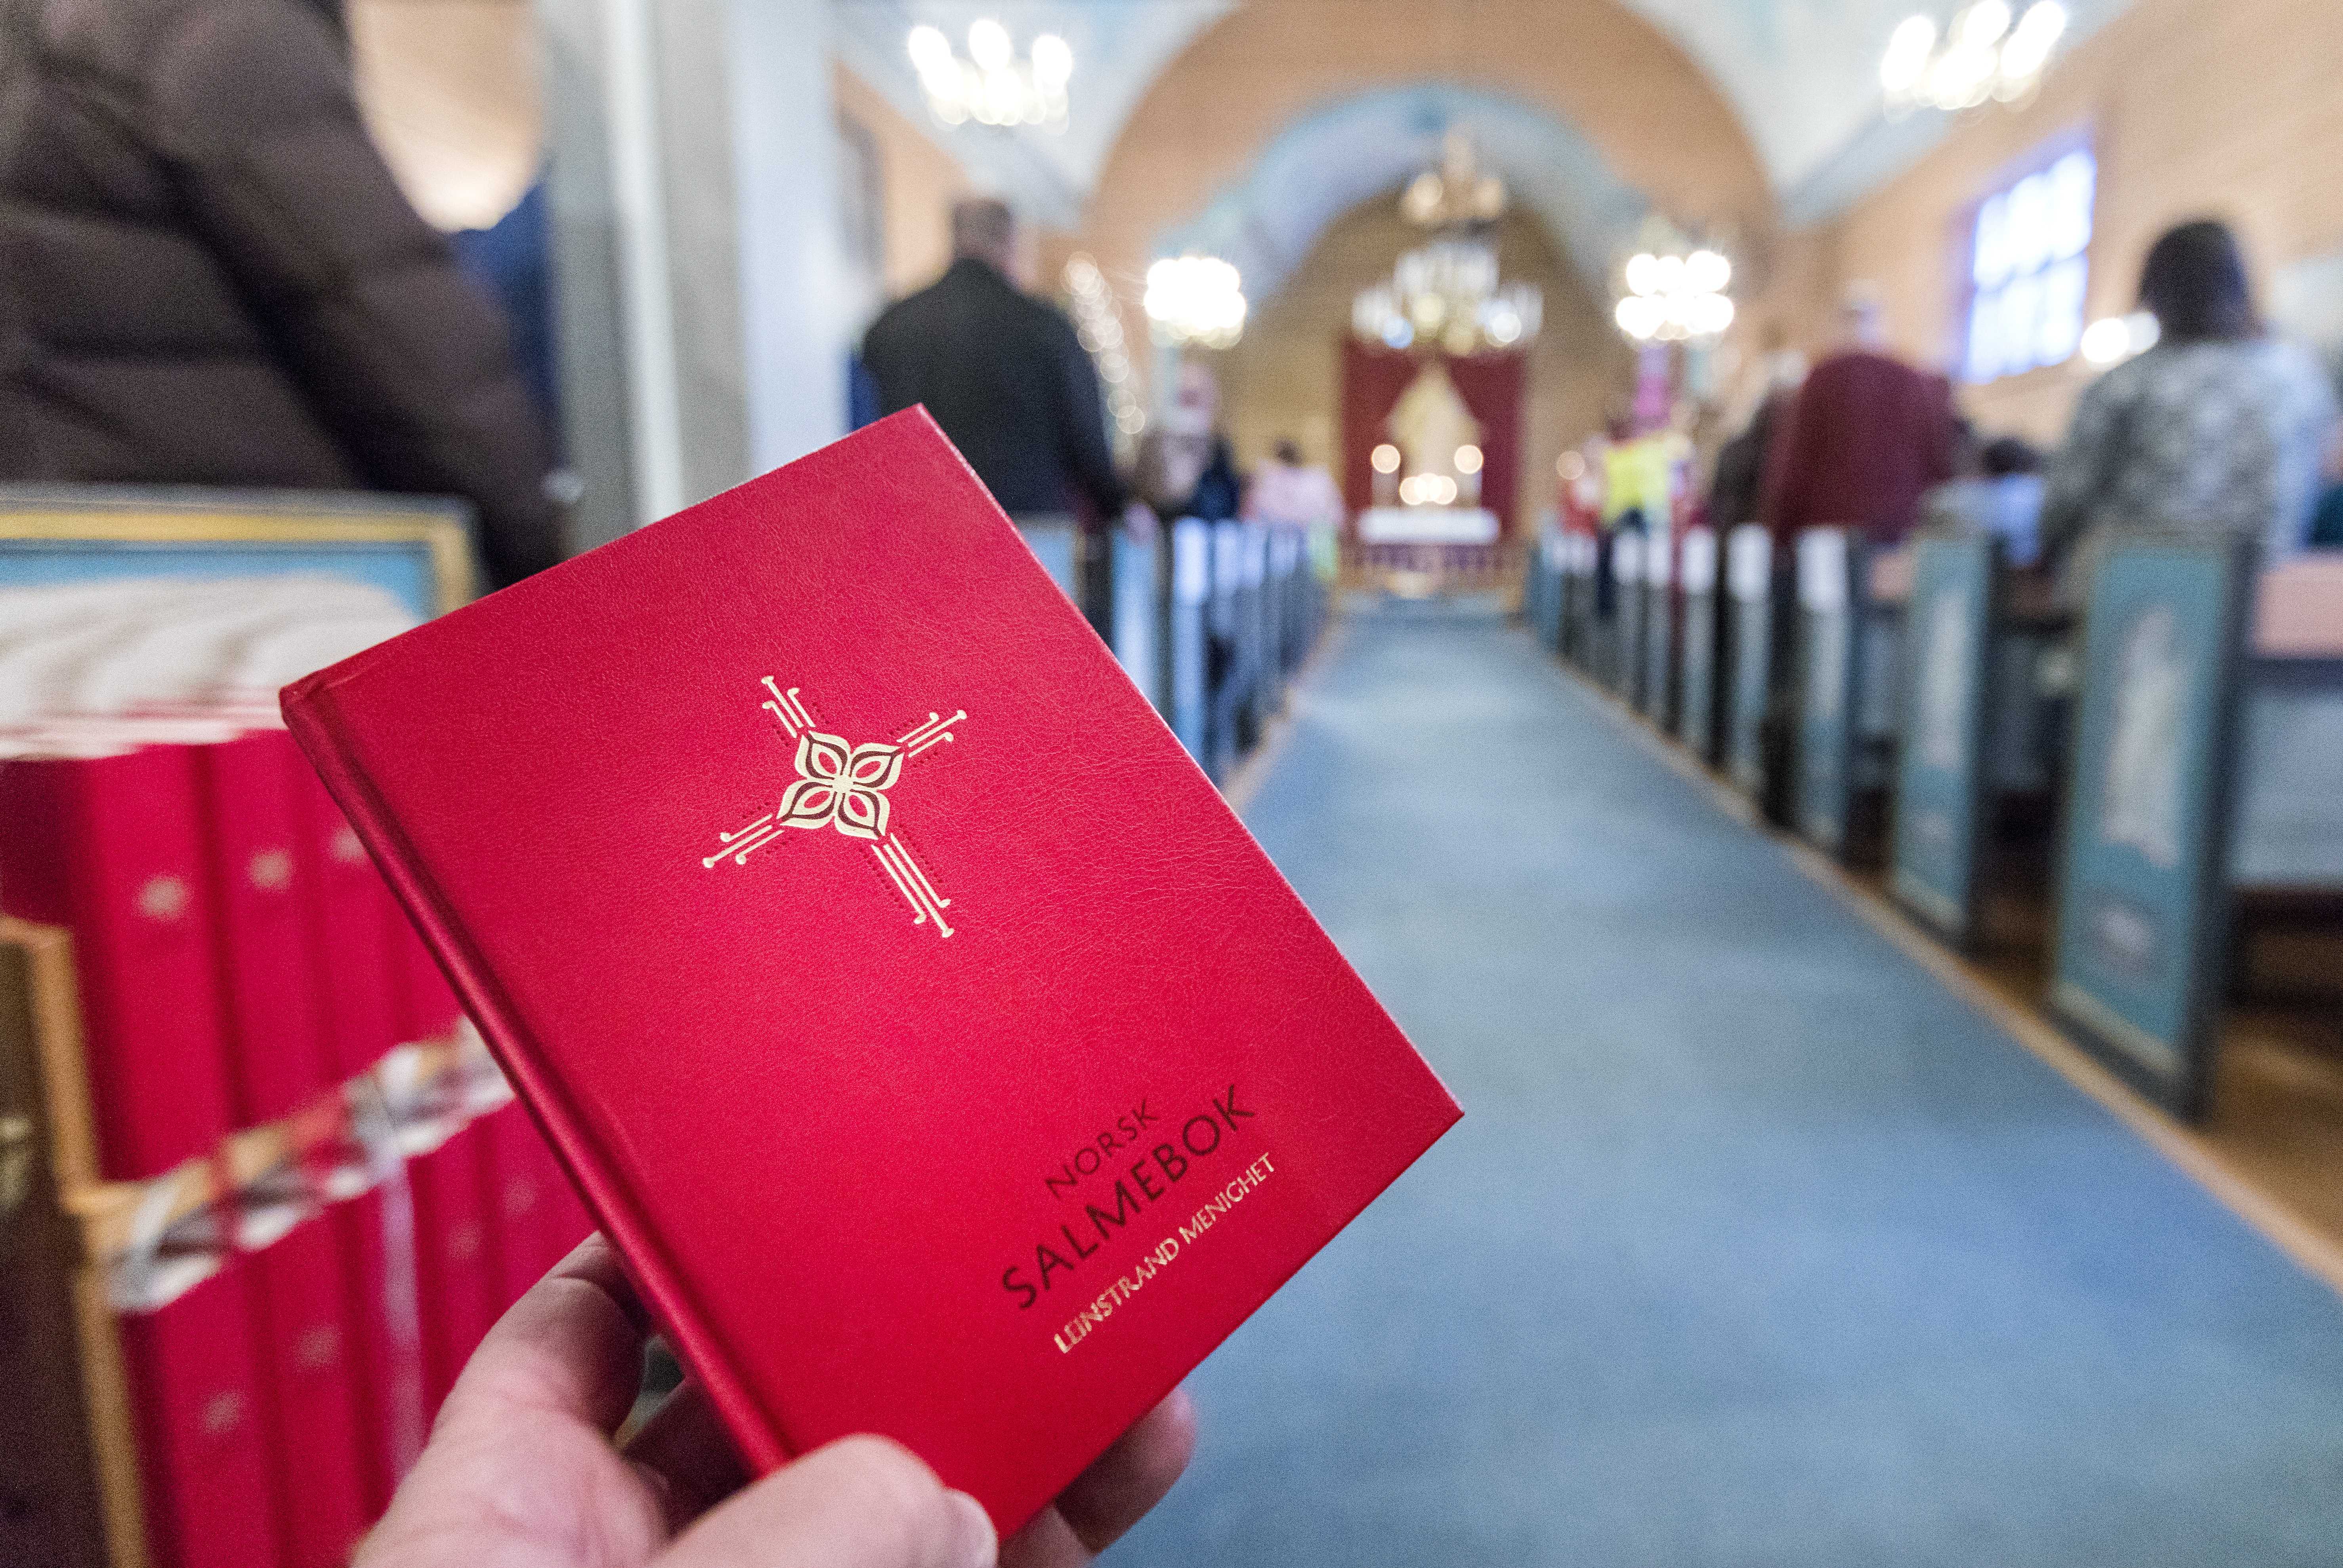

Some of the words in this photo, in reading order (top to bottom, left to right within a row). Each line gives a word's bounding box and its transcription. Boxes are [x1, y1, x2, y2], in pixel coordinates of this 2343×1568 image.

[1002, 1084, 1255, 1309] SALMEBOK
[1045, 1099, 1158, 1200] NORSK
[1054, 1237, 1179, 1353] LEINSTRAND
[1178, 1152, 1274, 1244] MENIGHET
